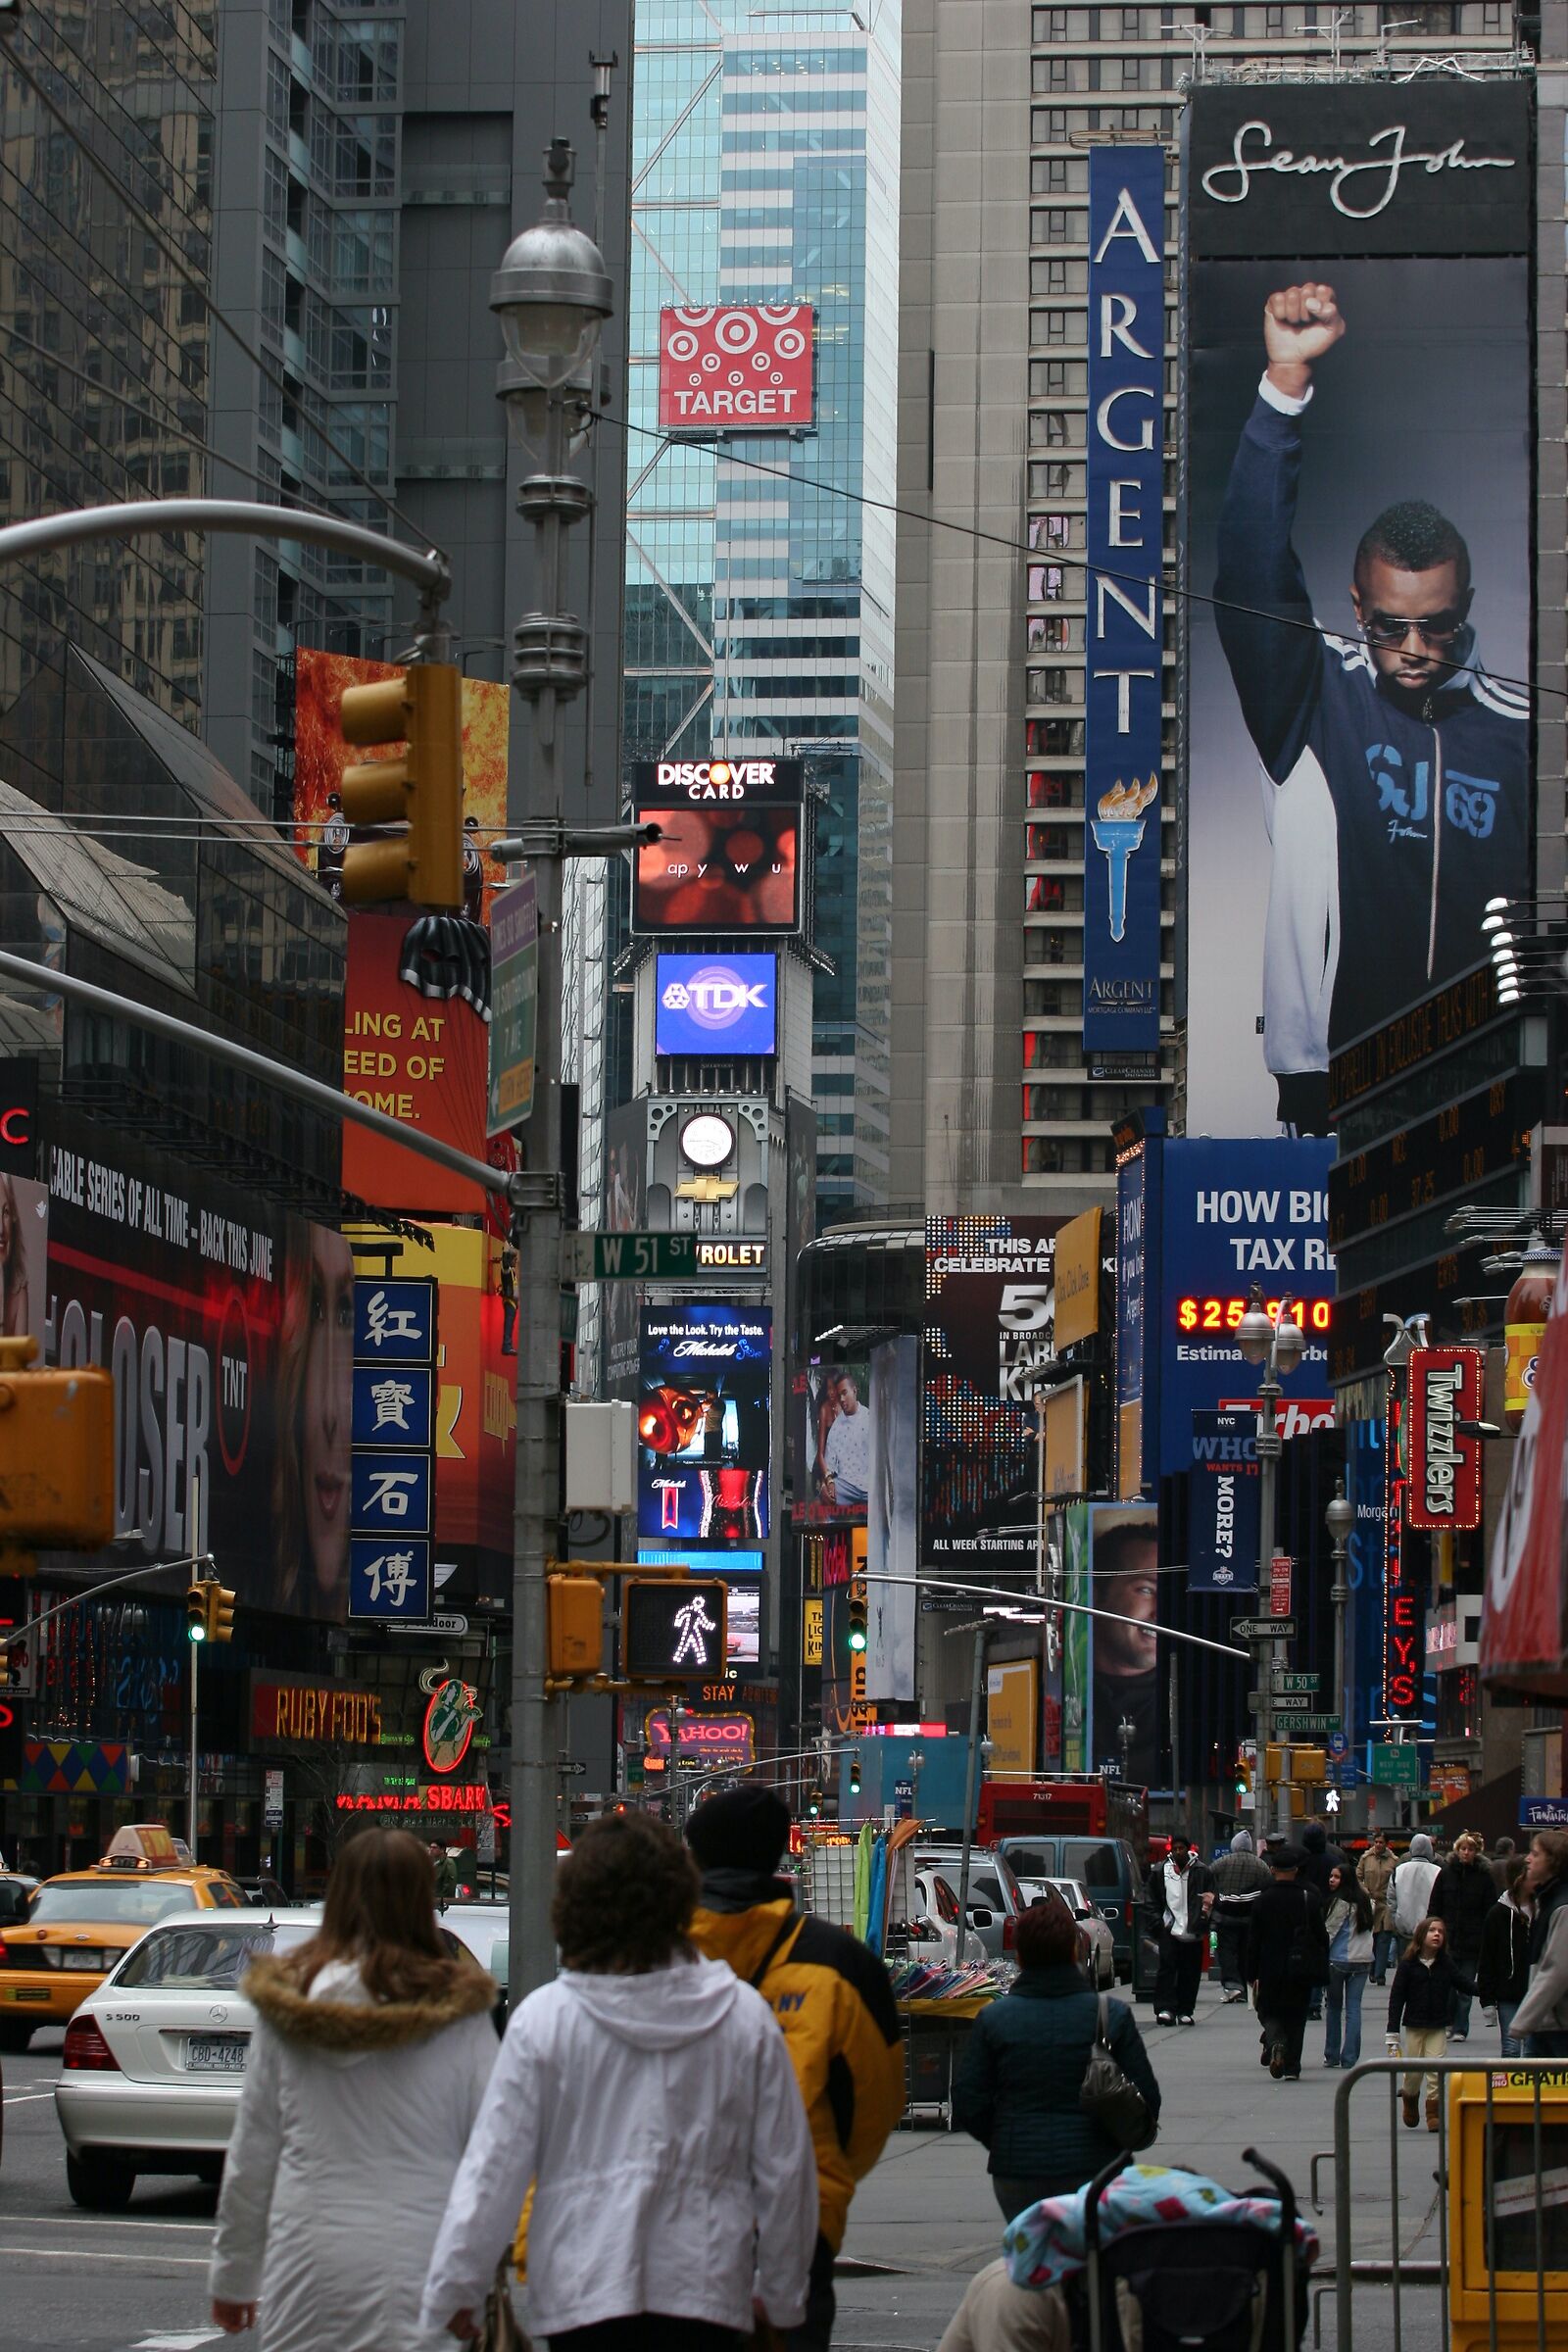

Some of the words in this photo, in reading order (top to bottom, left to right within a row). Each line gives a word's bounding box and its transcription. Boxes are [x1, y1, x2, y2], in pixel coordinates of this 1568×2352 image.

[1329, 125, 1515, 219] John
[673, 389, 798, 416] TARGET
[1093, 187, 1162, 734] ARGENT
[658, 761, 773, 786] DISCOVER
[688, 784, 745, 800] CARD
[688, 983, 768, 1008] TDK
[1089, 976, 1154, 999] ARGENT
[411, 1016, 445, 1042] AT
[407, 1056, 445, 1081] OF
[344, 1090, 420, 1119] OME.
[1196, 1190, 1281, 1224] HOW
[1289, 1190, 1330, 1224] BI
[87, 1160, 125, 1223] SERIES
[127, 1177, 142, 1229] OF
[143, 1183, 163, 1240] ALL
[165, 1193, 189, 1250] TIME
[200, 1209, 225, 1262] BACK
[227, 1220, 248, 1275] THIS
[249, 1231, 273, 1283] JUNE
[602, 1237, 622, 1275] W
[635, 1237, 658, 1275] 51
[669, 1238, 690, 1256] ST
[696, 1244, 764, 1266] ROLET
[986, 1238, 1031, 1254] THIS
[1230, 1238, 1298, 1272] TAX
[934, 1256, 1050, 1273] CELEBRATE
[647, 1324, 666, 1336] Love
[668, 1324, 683, 1336] the
[685, 1324, 708, 1336] Look.
[710, 1324, 722, 1338] Try
[723, 1324, 738, 1336] the
[740, 1324, 764, 1336] Taste.
[1000, 1331, 1010, 1340] IN
[1013, 1331, 1054, 1340] BROADC
[673, 1340, 736, 1358] Michelob
[1177, 1345, 1248, 1361] Estima
[221, 1355, 248, 1410] TNT
[60, 1298, 212, 1556] OSER
[1217, 1417, 1236, 1426] NYC
[1426, 1363, 1465, 1515] Twizzlers
[1206, 1462, 1244, 1473] WANTS
[1215, 1475, 1235, 1559] MORE?
[933, 1539, 950, 1551] ALL
[952, 1539, 978, 1551] WEEK
[980, 1539, 1024, 1551] STARTING
[811, 1611, 822, 1621] TH
[1240, 1623, 1258, 1634] ONE
[1269, 1623, 1290, 1634] WAY
[1285, 1676, 1295, 1690] W
[1296, 1676, 1307, 1690] 50
[702, 1686, 736, 1701] STAY
[1286, 1697, 1304, 1708] WAY
[276, 1687, 328, 1740] RUBY
[331, 1691, 382, 1745] FOO'S
[1276, 1716, 1327, 1730] GERSHWIN
[1100, 1764, 1121, 1775] NFL
[895, 1786, 912, 1795] NFL
[106, 2012, 115, 2022] S
[117, 2012, 141, 2022] 500
